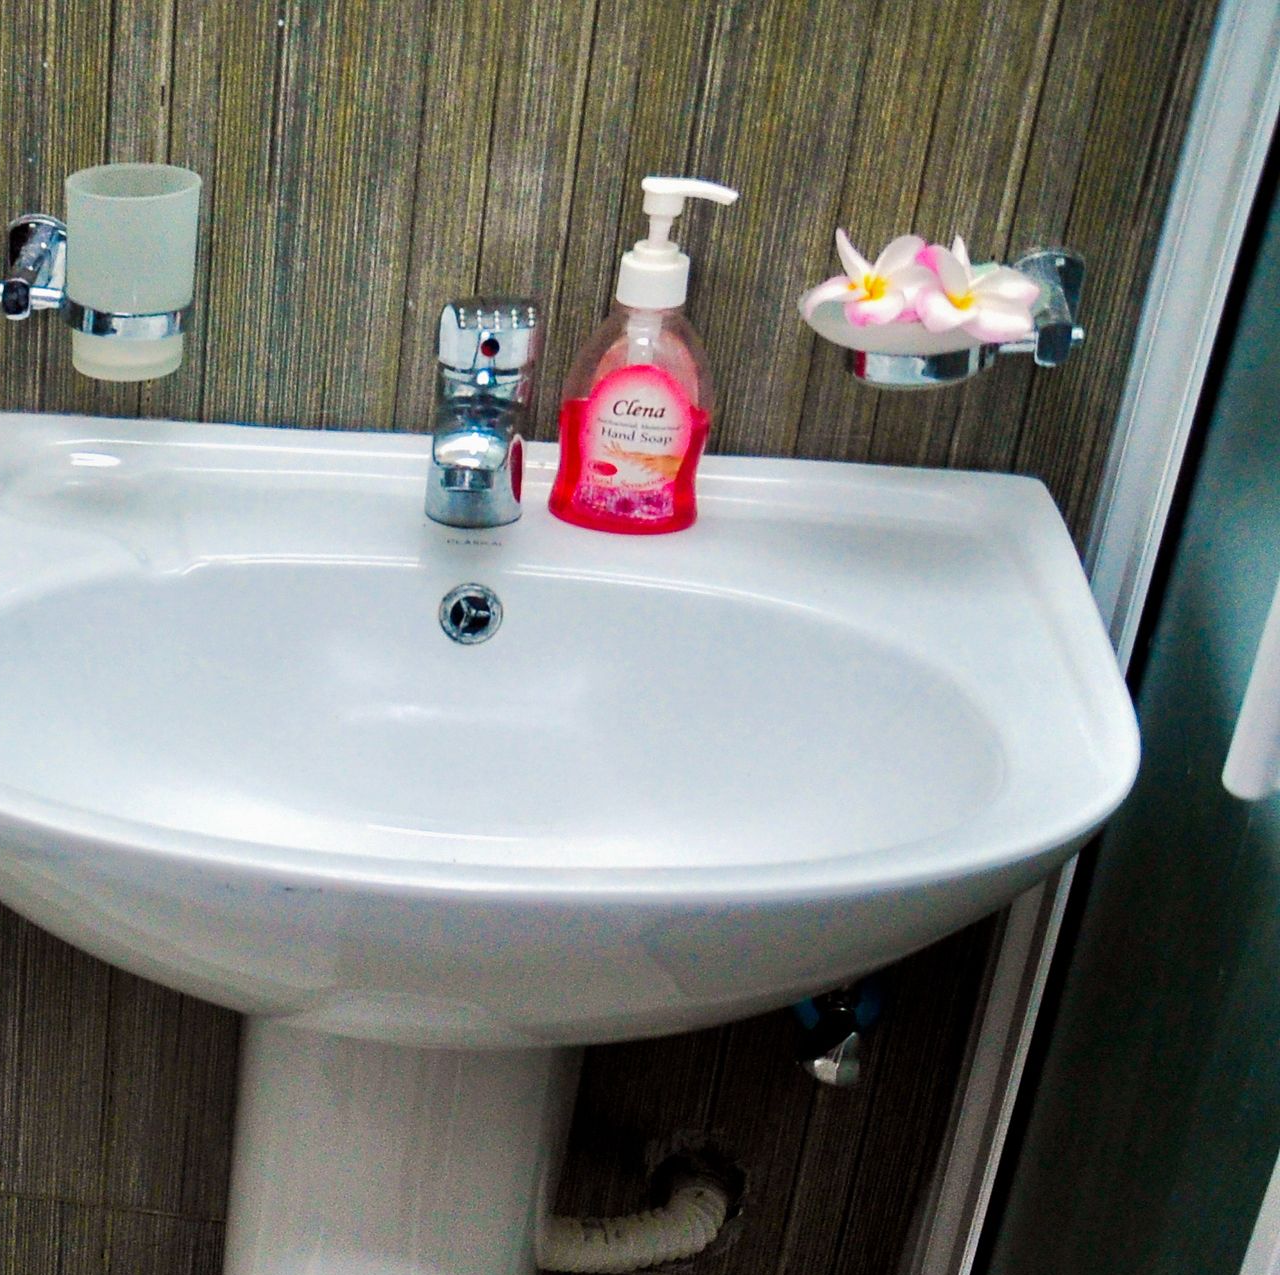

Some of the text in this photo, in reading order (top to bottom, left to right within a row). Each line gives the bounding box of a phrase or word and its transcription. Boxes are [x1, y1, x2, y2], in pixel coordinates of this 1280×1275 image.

[612, 399, 666, 419] Clena
[600, 426, 673, 446] Hand Soap
